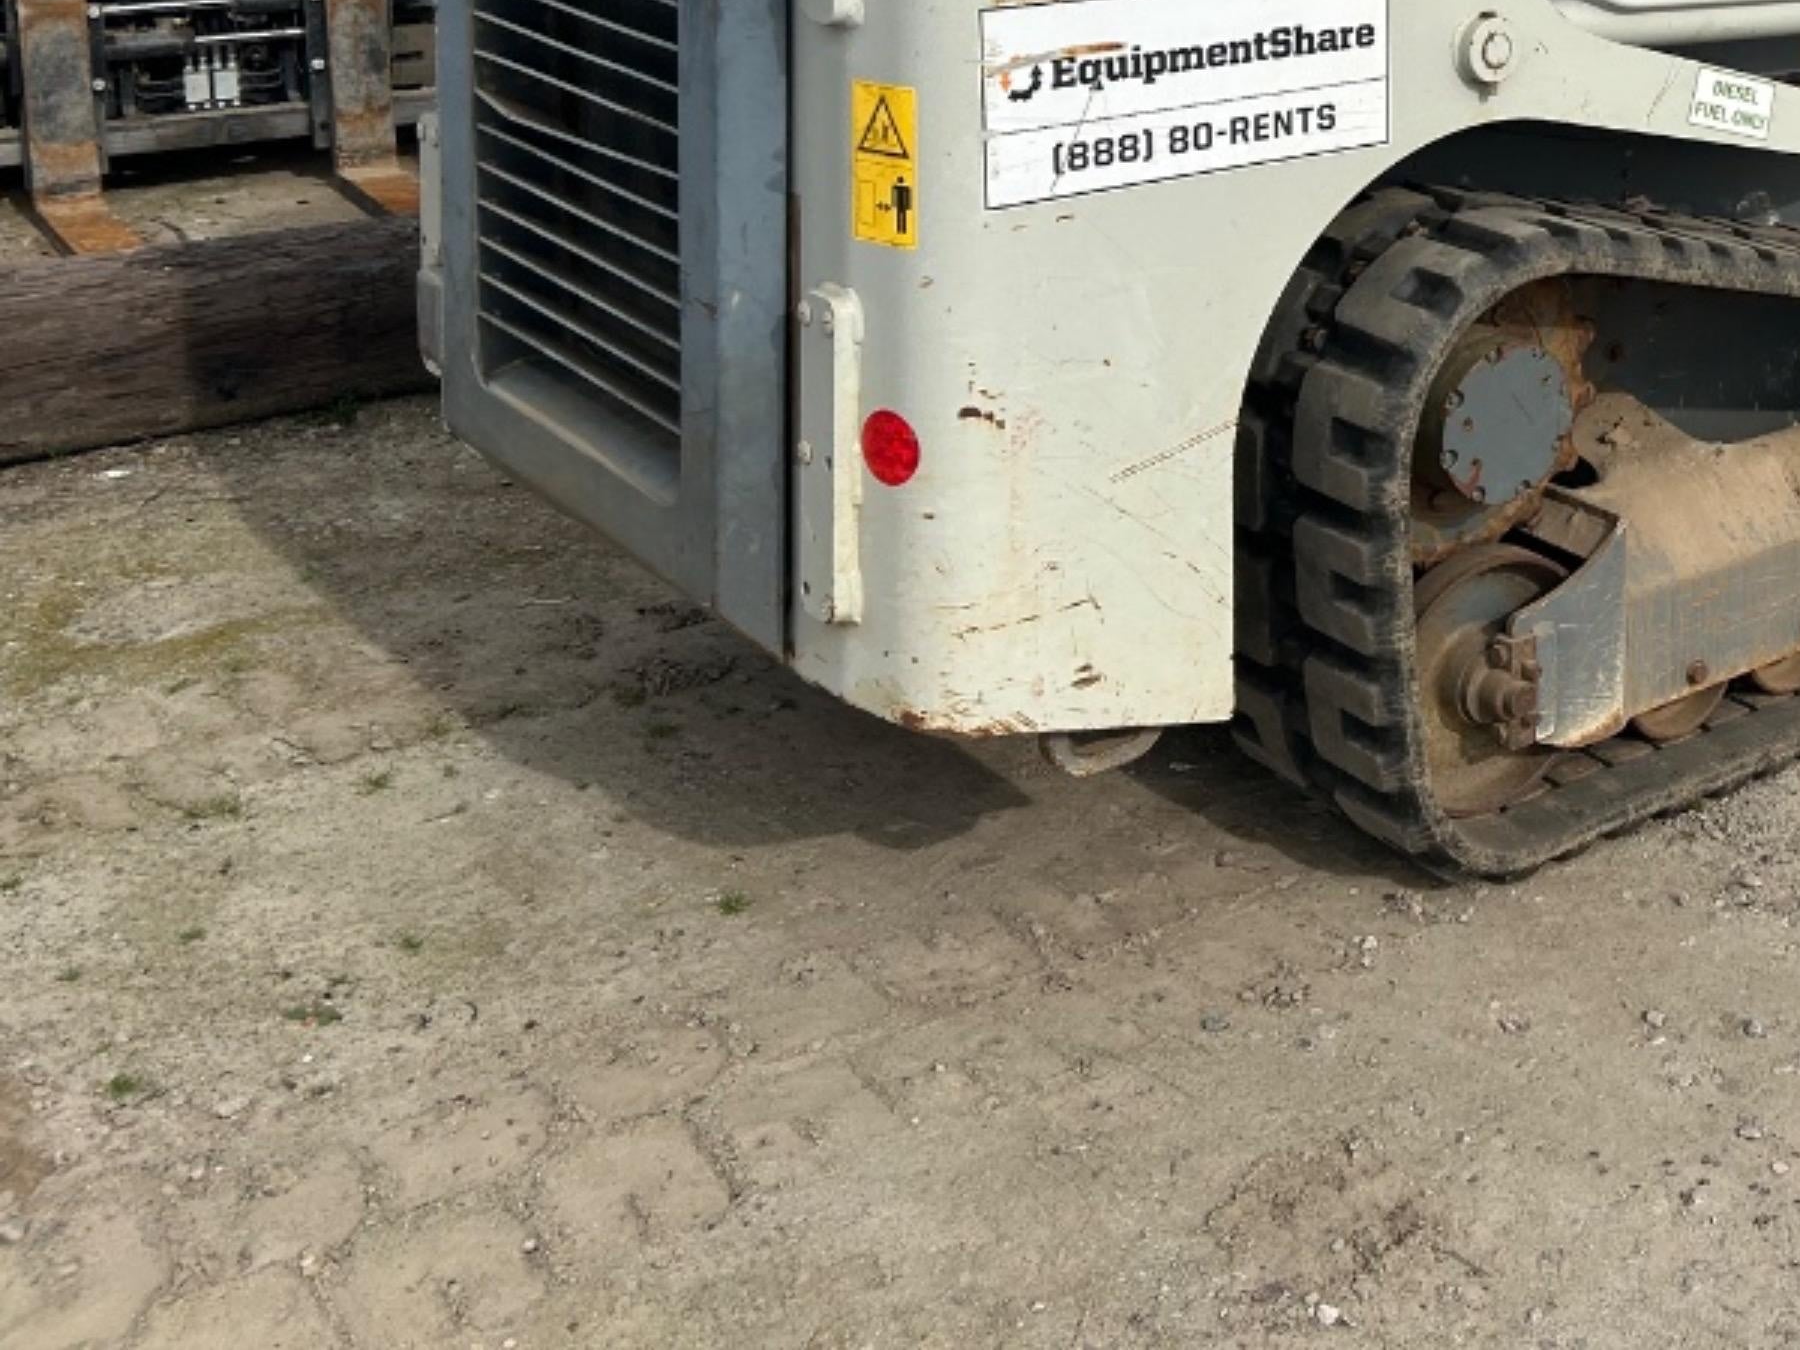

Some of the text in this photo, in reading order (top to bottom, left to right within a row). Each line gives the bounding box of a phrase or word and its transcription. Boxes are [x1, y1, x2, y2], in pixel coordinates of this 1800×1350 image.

[1052, 23, 1375, 90] EquipmentShare
[1694, 102, 1728, 123] FUEL
[1713, 80, 1758, 105] DIESEL
[1053, 104, 1337, 175] (888) 80-RENTS
